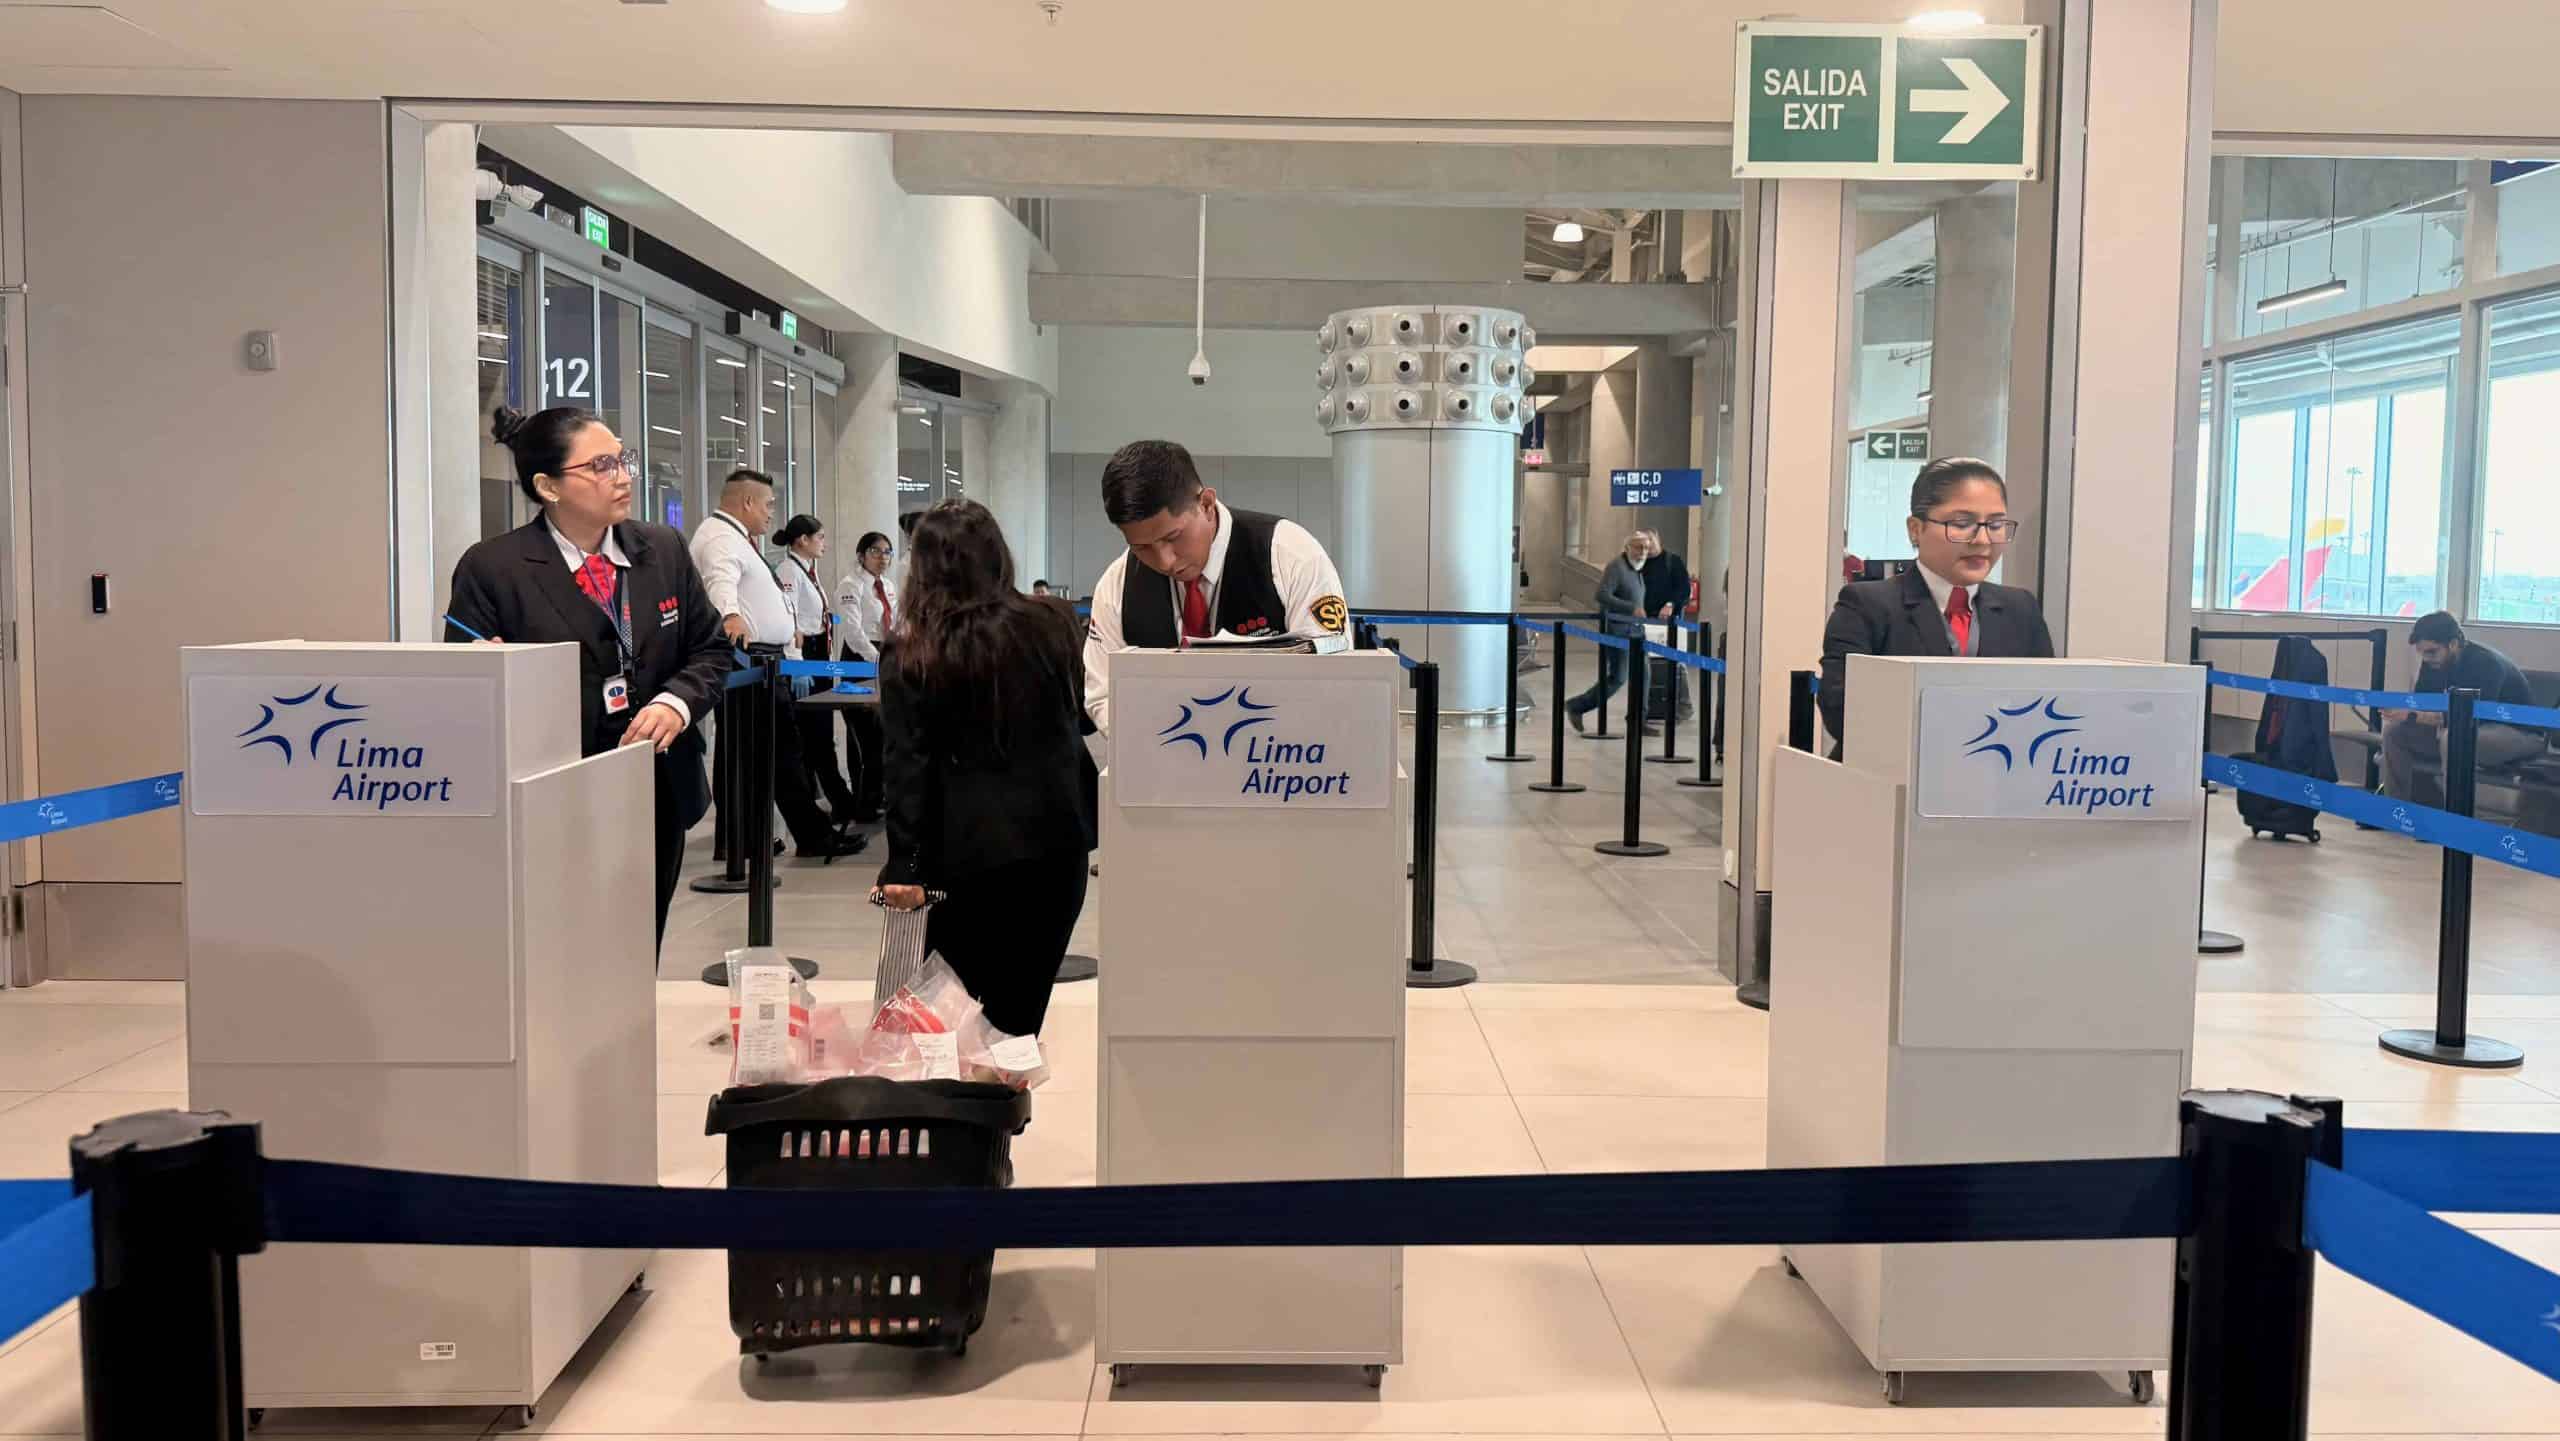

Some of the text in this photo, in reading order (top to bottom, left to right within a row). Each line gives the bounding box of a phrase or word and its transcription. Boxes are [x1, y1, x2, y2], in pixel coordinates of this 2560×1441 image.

[1763, 68, 1868, 97] SALIDA
[1783, 102, 1845, 131] EXIT
[1641, 472, 1662, 486] C,D
[337, 737, 424, 768] Lima
[1247, 736, 1325, 763] Lima
[2052, 747, 2130, 775] Lima
[332, 773, 453, 810] Airport
[1241, 768, 1350, 802] Airport
[2045, 780, 2154, 815] Airport
